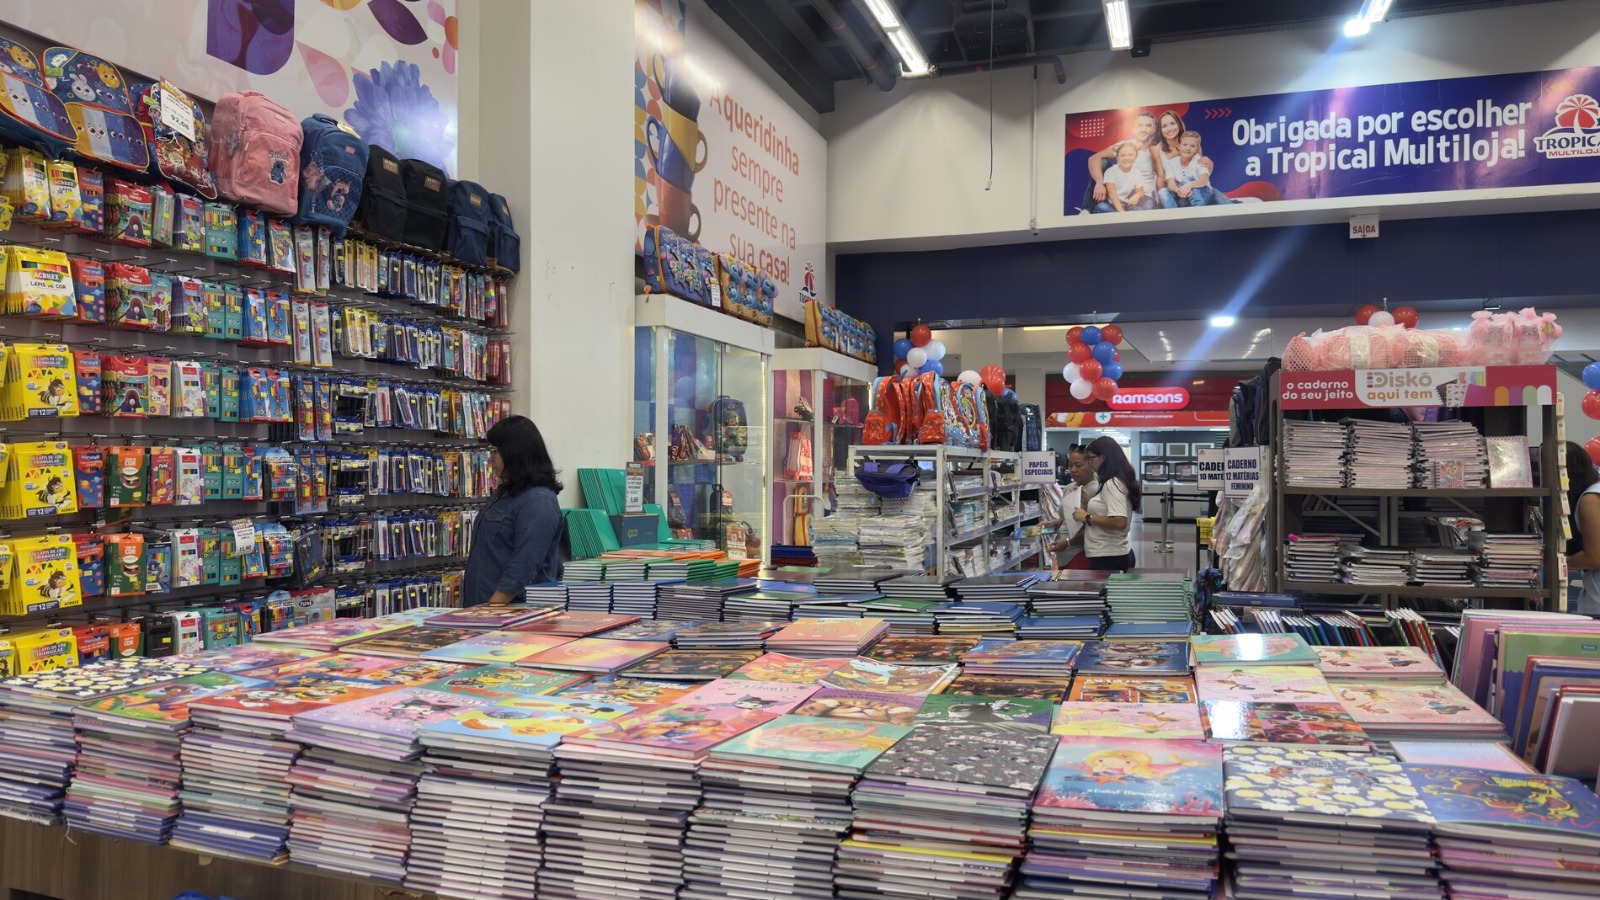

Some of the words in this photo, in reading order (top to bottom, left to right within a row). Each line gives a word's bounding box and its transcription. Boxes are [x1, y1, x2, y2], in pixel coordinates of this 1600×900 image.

[709, 82, 722, 116] A
[723, 94, 799, 176] queridinha
[1232, 112, 1352, 149] Obrigada
[1357, 111, 1404, 143] por
[1411, 99, 1532, 132] escolher
[1245, 156, 1261, 177] a
[1266, 140, 1376, 178] Tropical
[1384, 129, 1525, 168] Multiloja!
[1549, 149, 1600, 158] MULTILOJ
[731, 145, 783, 203] sempre
[714, 178, 778, 240] presente
[782, 220, 796, 251] na
[1352, 224, 1376, 234] SAÍDA
[730, 233, 755, 266] sua
[759, 249, 790, 286] casa!
[1297, 379, 1349, 390] caderno
[1282, 391, 1297, 400] do
[1301, 391, 1321, 400] seu
[1324, 389, 1354, 402] jeito
[1367, 388, 1399, 402] aqui
[1404, 389, 1433, 399] tem
[1029, 460, 1049, 468] PAPÉIS
[1227, 459, 1257, 469] CADERNO
[1225, 472, 1232, 480] 12
[1232, 471, 1260, 480] MATÉRIAS
[1231, 482, 1254, 490] FEMININO
